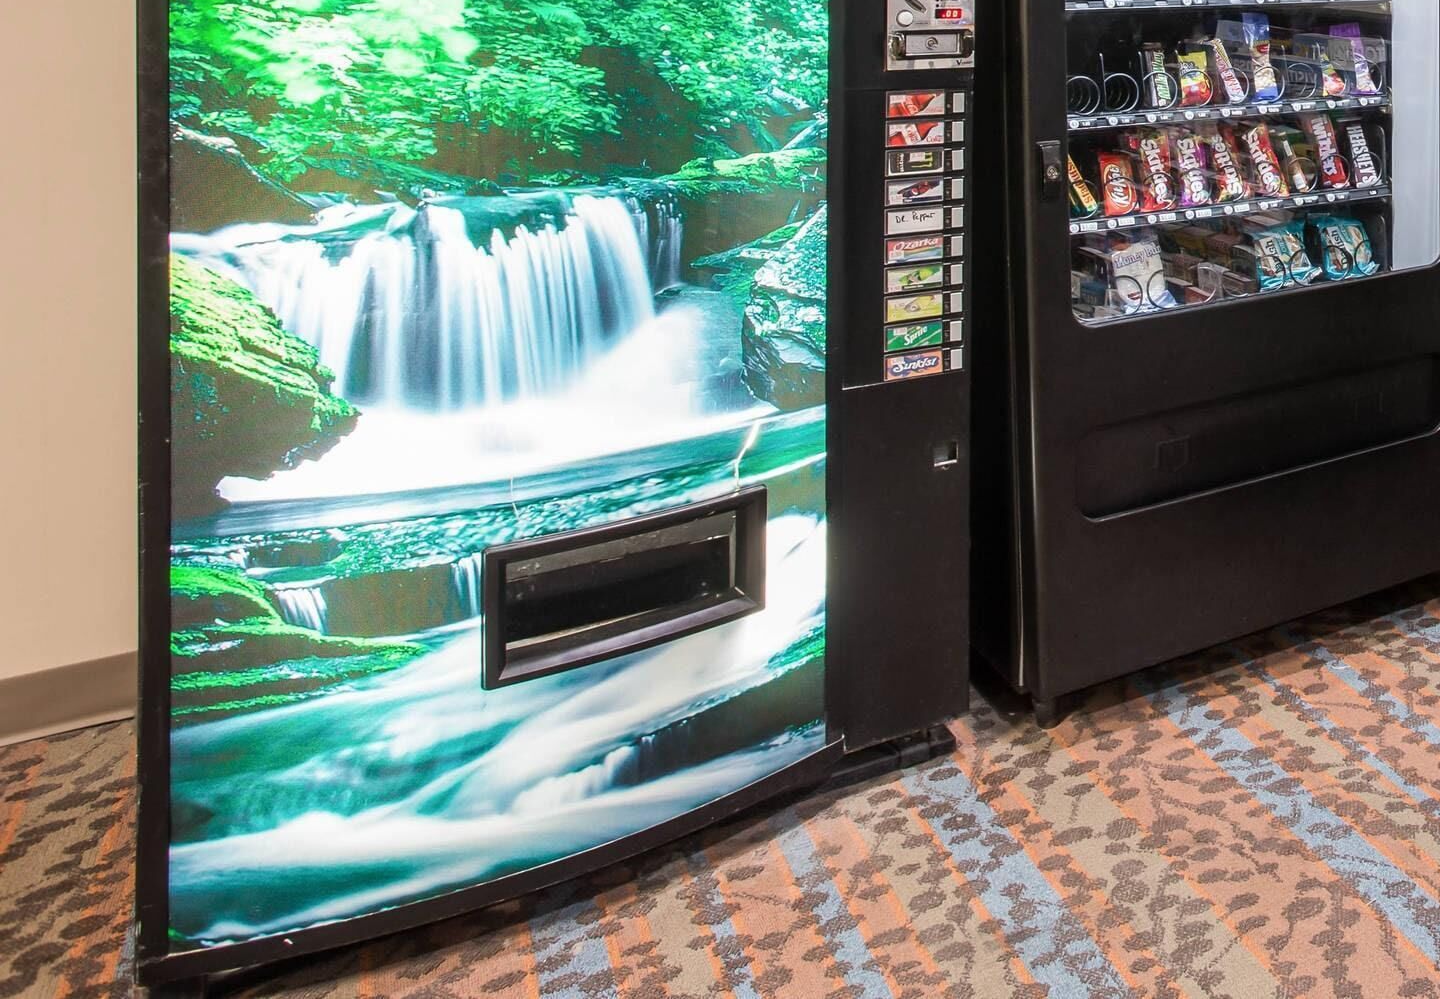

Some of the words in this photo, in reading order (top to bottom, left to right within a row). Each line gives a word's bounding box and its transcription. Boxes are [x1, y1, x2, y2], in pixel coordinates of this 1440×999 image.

[1346, 125, 1378, 186] HERSHEY'S
[893, 237, 939, 251] Ozarka
[1115, 250, 1145, 268] Honey
[904, 326, 928, 346] Sprite
[892, 357, 937, 373] Sunkist
